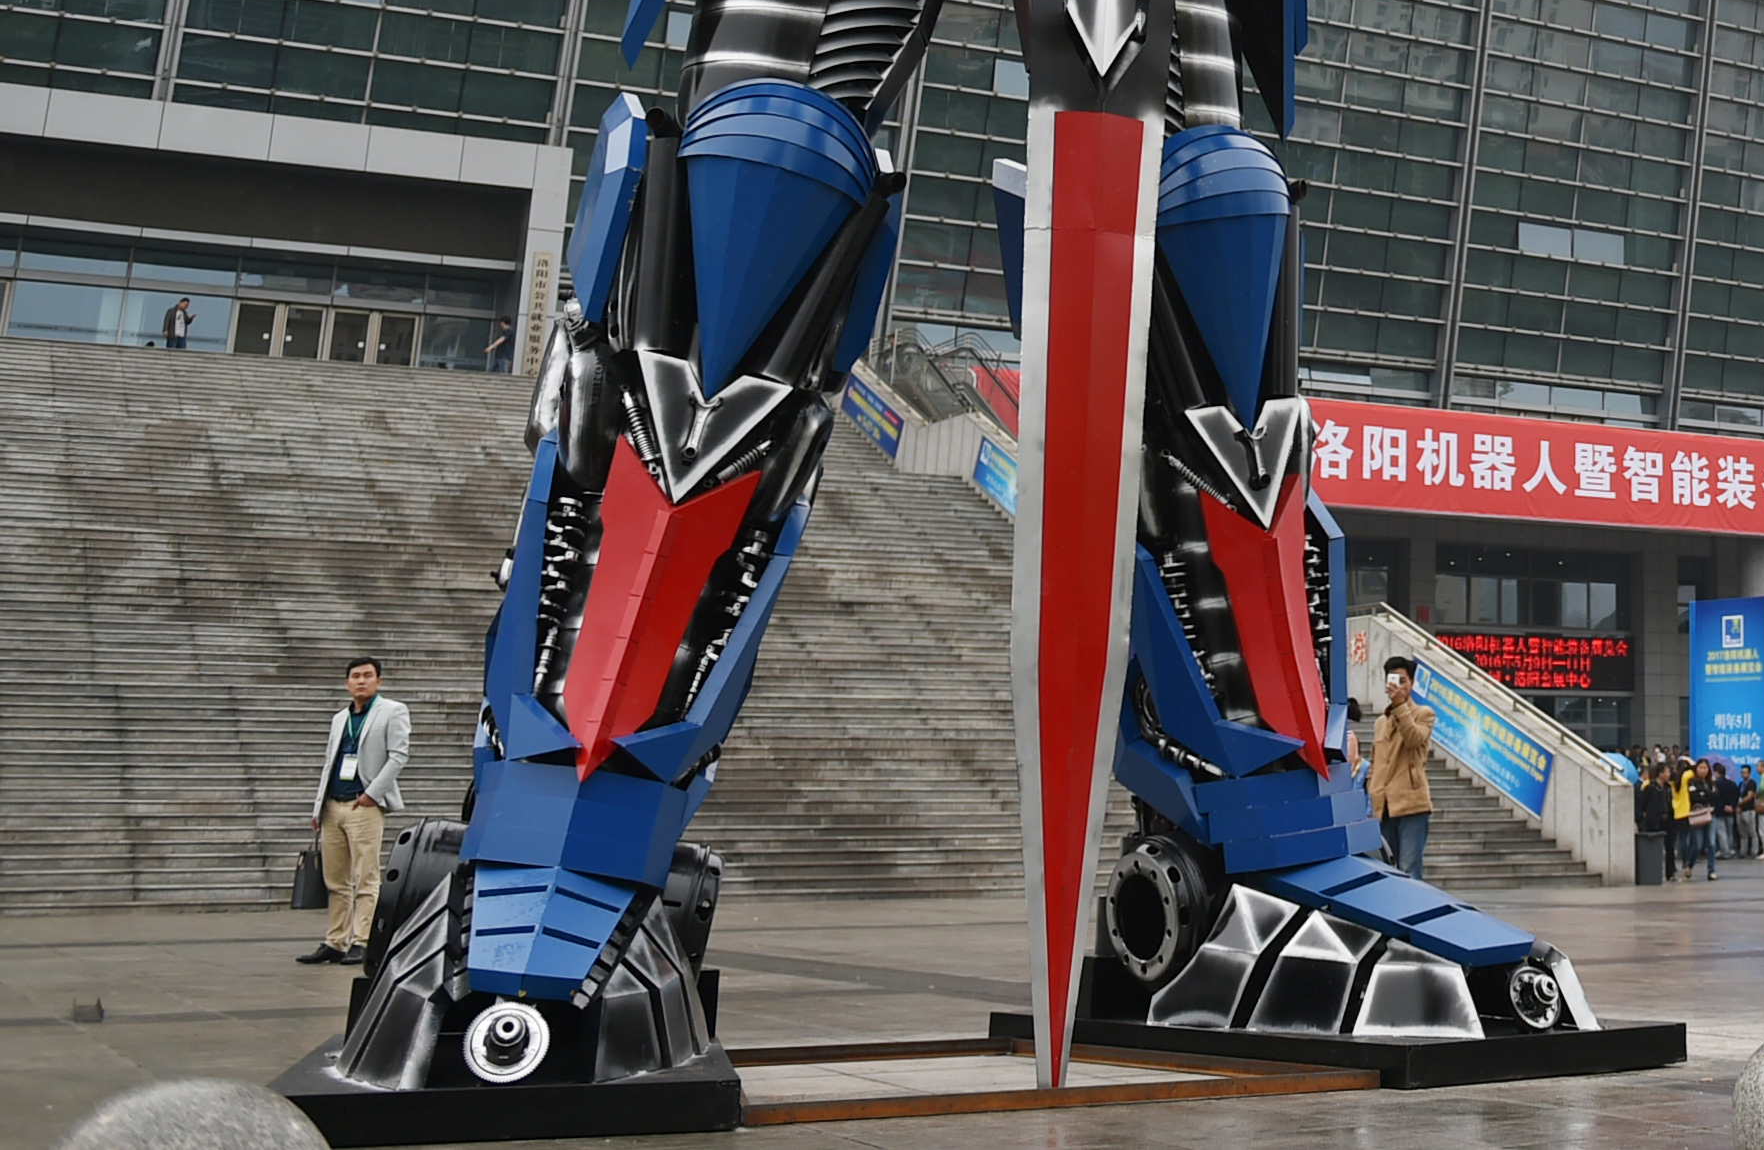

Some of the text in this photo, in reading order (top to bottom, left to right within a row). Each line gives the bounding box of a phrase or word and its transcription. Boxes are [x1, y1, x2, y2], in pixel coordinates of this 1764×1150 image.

[524, 258, 549, 376] 洛阳市公共就业服务中心
[1714, 712, 1752, 730] 明年5月
[1707, 731, 1761, 750] 我们再相会
